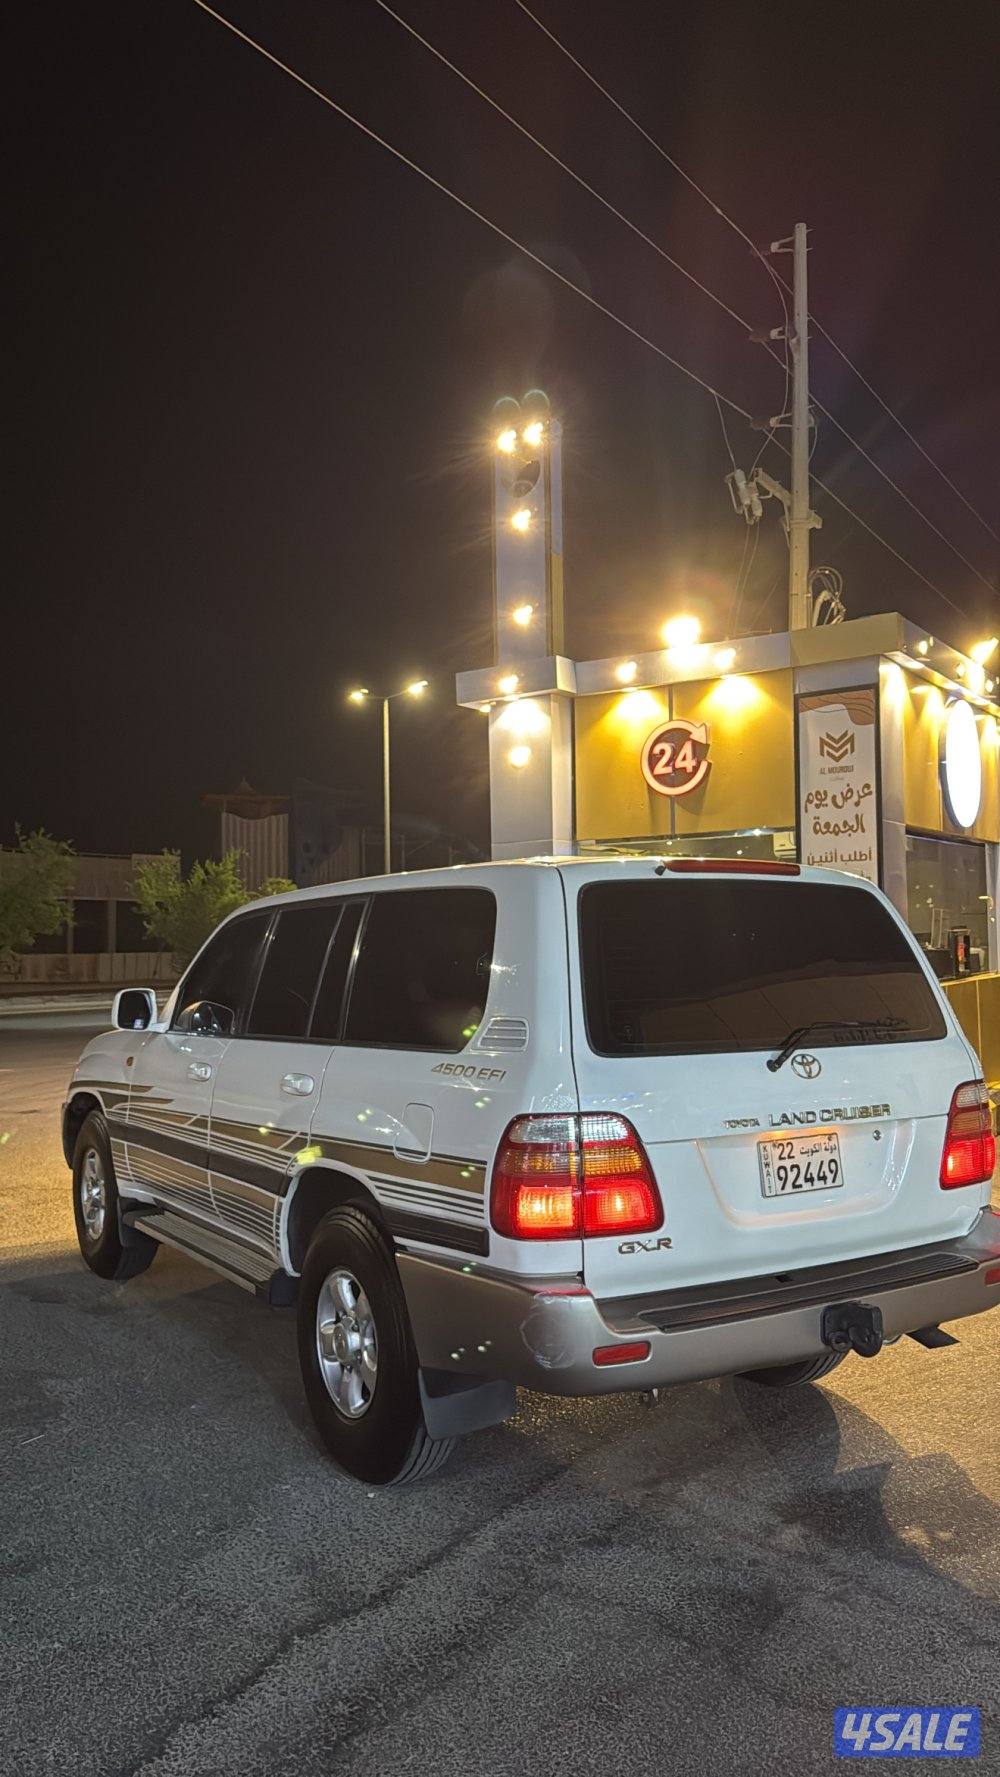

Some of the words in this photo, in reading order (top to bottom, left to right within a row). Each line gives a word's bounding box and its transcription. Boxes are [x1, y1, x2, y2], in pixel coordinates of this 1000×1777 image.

[652, 740, 698, 775] 24
[804, 789, 828, 813] يوم
[831, 783, 873, 809] عرض
[813, 813, 866, 837] الجمعة
[431, 1063, 477, 1078] 4500
[477, 1068, 507, 1081] EFI
[723, 1118, 761, 1128] TOYOTA
[769, 1111, 817, 1127] LAND
[819, 1104, 892, 1122] CRUISER
[777, 1142, 795, 1160] 22
[777, 1159, 839, 1191] 92449
[618, 1237, 674, 1254] GXR
